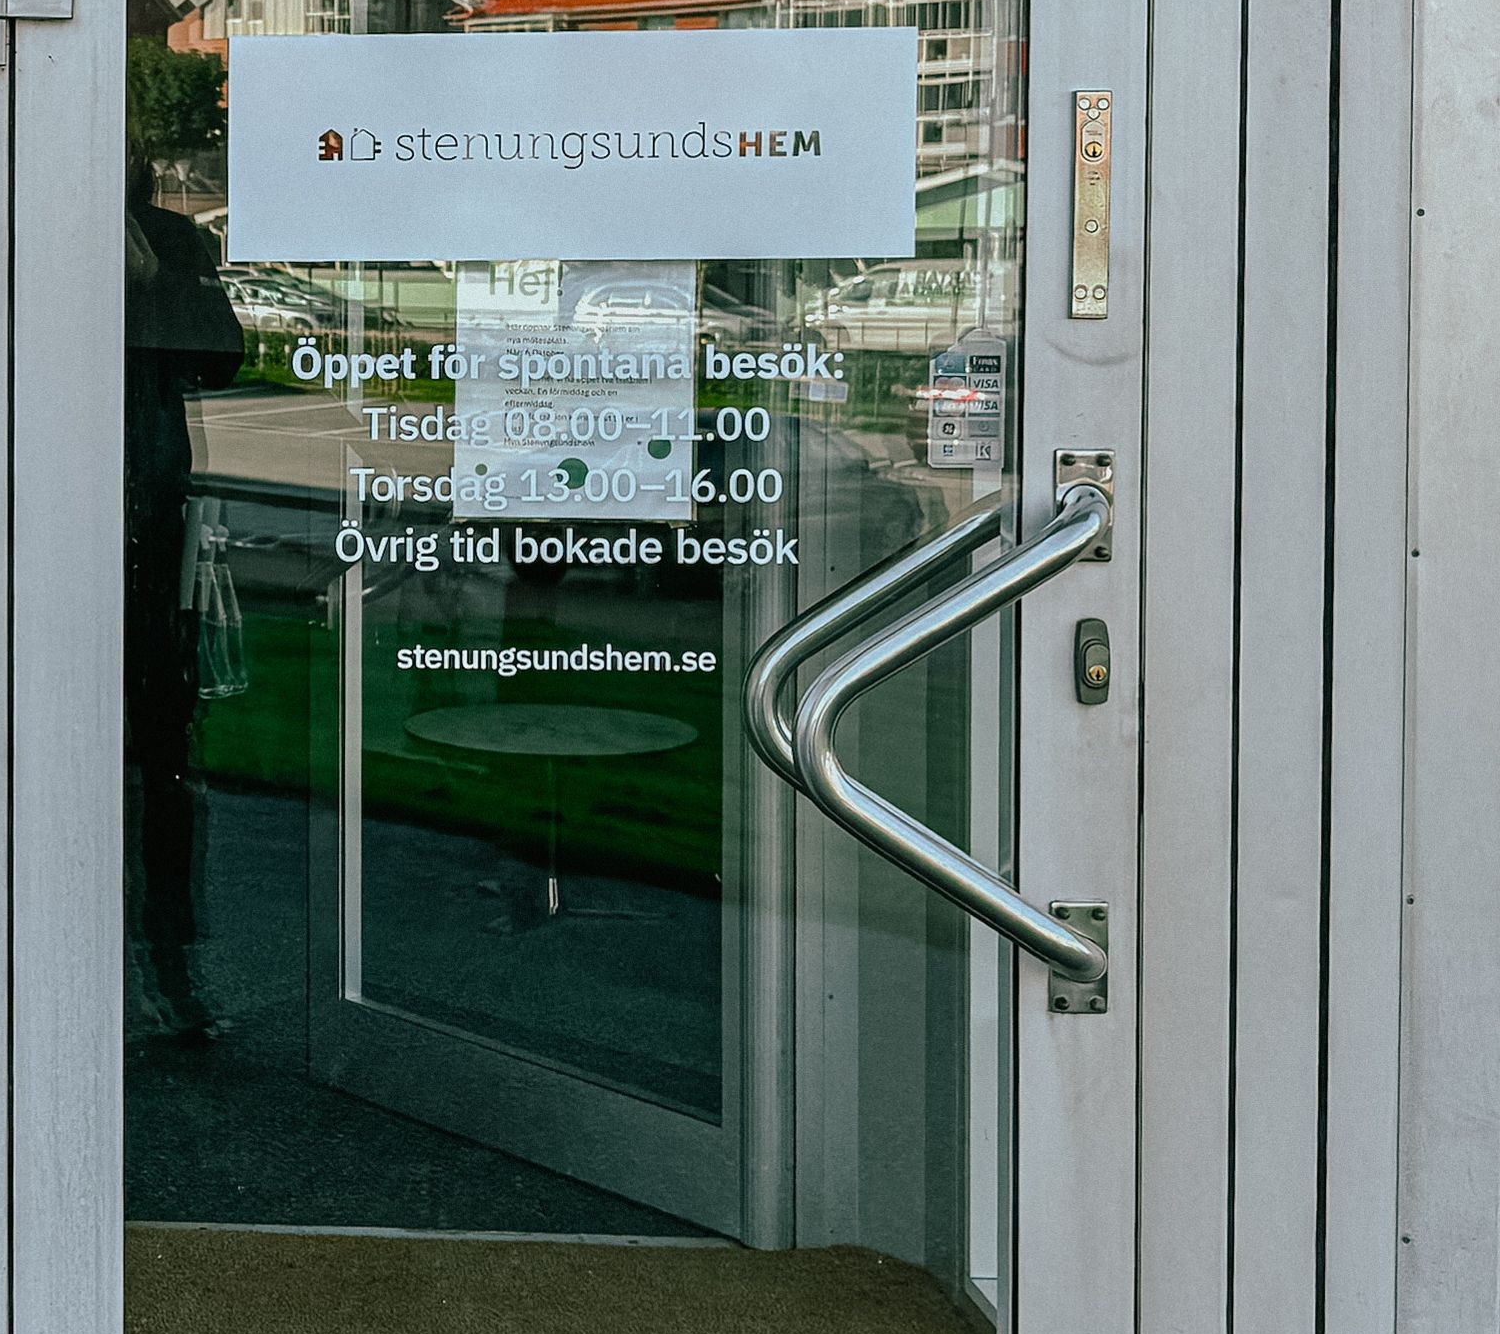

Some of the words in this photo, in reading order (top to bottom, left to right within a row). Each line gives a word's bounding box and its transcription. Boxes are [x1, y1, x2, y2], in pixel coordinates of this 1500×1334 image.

[395, 122, 822, 170] stenungsundsHEM
[488, 261, 564, 304] Hej!
[291, 337, 416, 389] Öppet
[428, 343, 486, 380] för
[498, 347, 692, 389] spontana
[706, 343, 844, 380] besök:
[973, 379, 999, 389] VISA
[362, 406, 492, 448] Tisdag
[350, 468, 509, 511] Torsdag
[335, 520, 440, 571] Övrig
[449, 528, 499, 563] tid
[515, 528, 664, 564] bokade
[677, 528, 799, 565] besök
[397, 643, 717, 677] stenungsundshem.se
